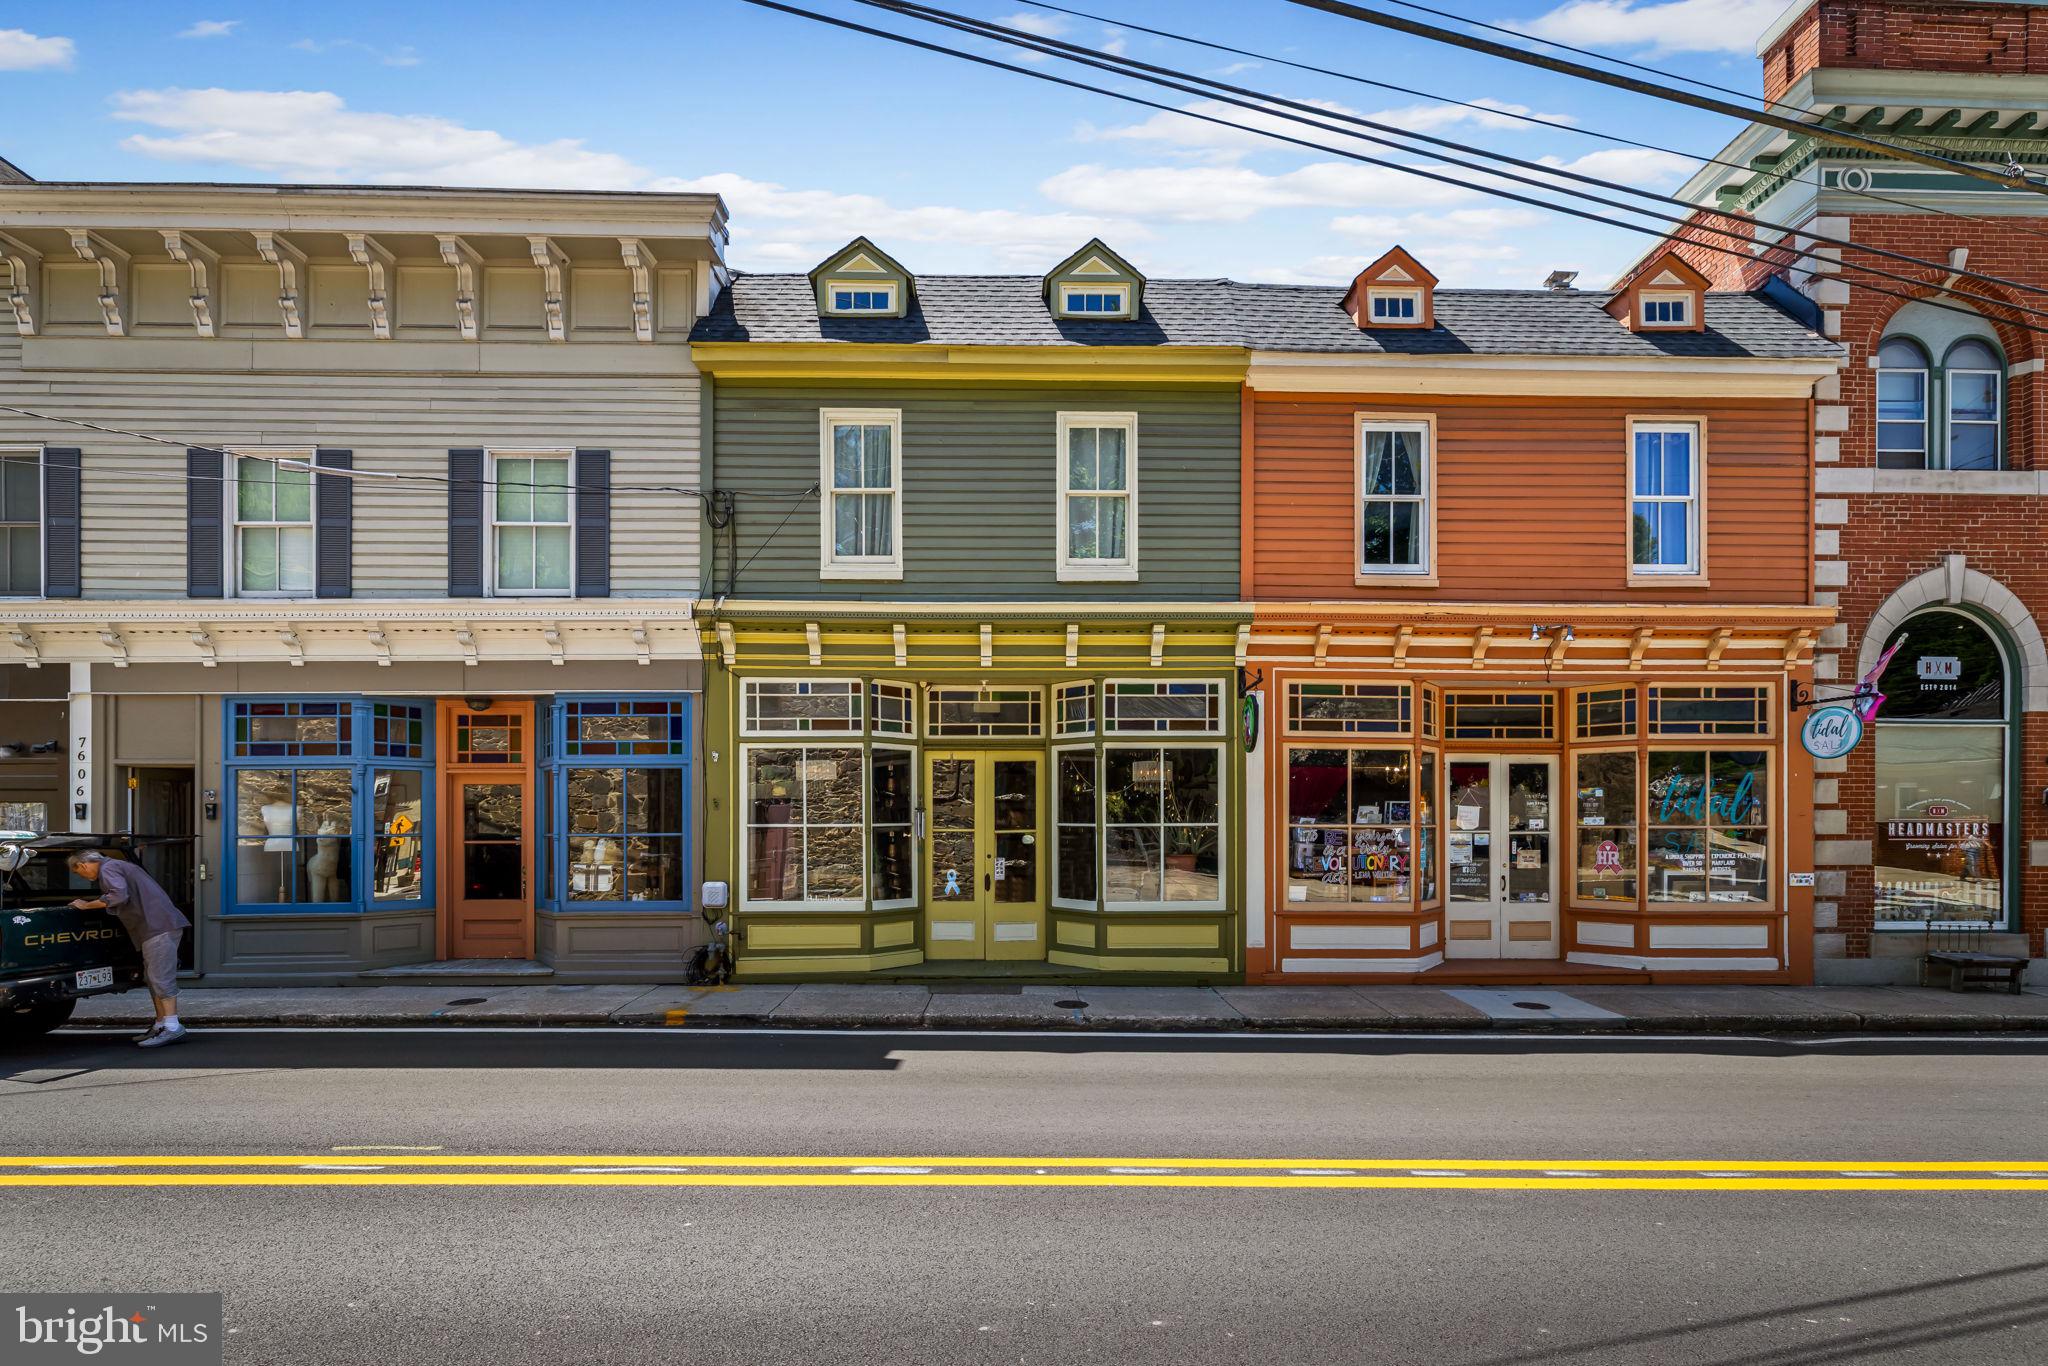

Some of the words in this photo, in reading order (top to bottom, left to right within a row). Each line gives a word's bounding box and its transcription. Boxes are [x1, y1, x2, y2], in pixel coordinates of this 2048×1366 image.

[1811, 714, 1849, 739] tidal
[1659, 771, 1754, 825] tidal
[1888, 822, 1989, 837] HEADMASTERS
[1325, 831, 1343, 845] BE
[1597, 850, 1620, 865] HR
[24, 929, 125, 946] CHEVROL
